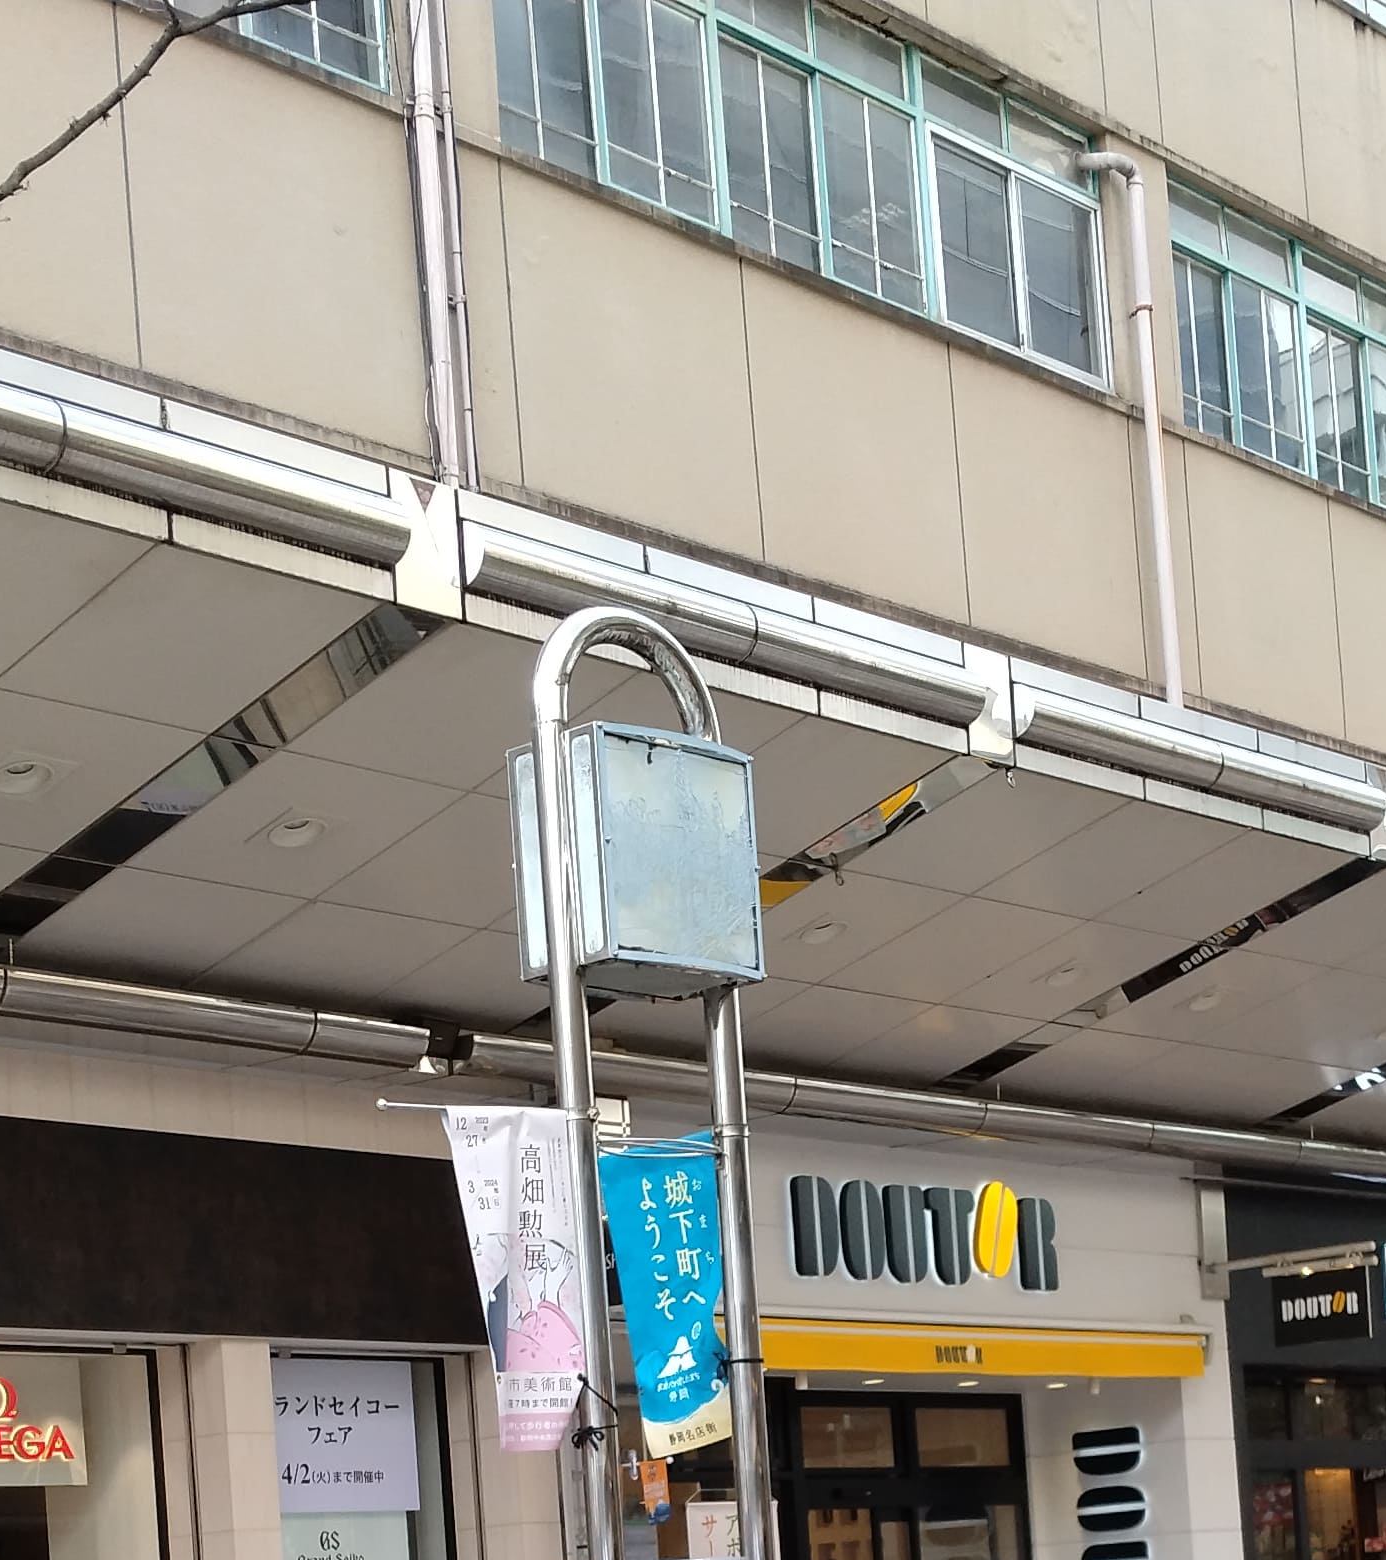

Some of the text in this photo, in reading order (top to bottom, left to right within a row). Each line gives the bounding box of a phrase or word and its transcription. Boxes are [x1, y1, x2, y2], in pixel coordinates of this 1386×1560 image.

[465, 1134, 478, 1148] 27
[467, 1180, 476, 1193] 3
[518, 1143, 548, 1272] 高畑勲展
[663, 1170, 707, 1305] 城下町へ
[788, 1173, 1060, 1293] DOUTOR
[639, 1177, 677, 1321] ようこそ
[1281, 1290, 1359, 1323] DOUTOR
[935, 1344, 983, 1365] DOUTOR
[508, 1376, 572, 1393] 市美術館
[274, 1394, 400, 1418] ランドセイコー
[307, 1426, 354, 1445] フェア
[319, 1530, 341, 1551] GS
